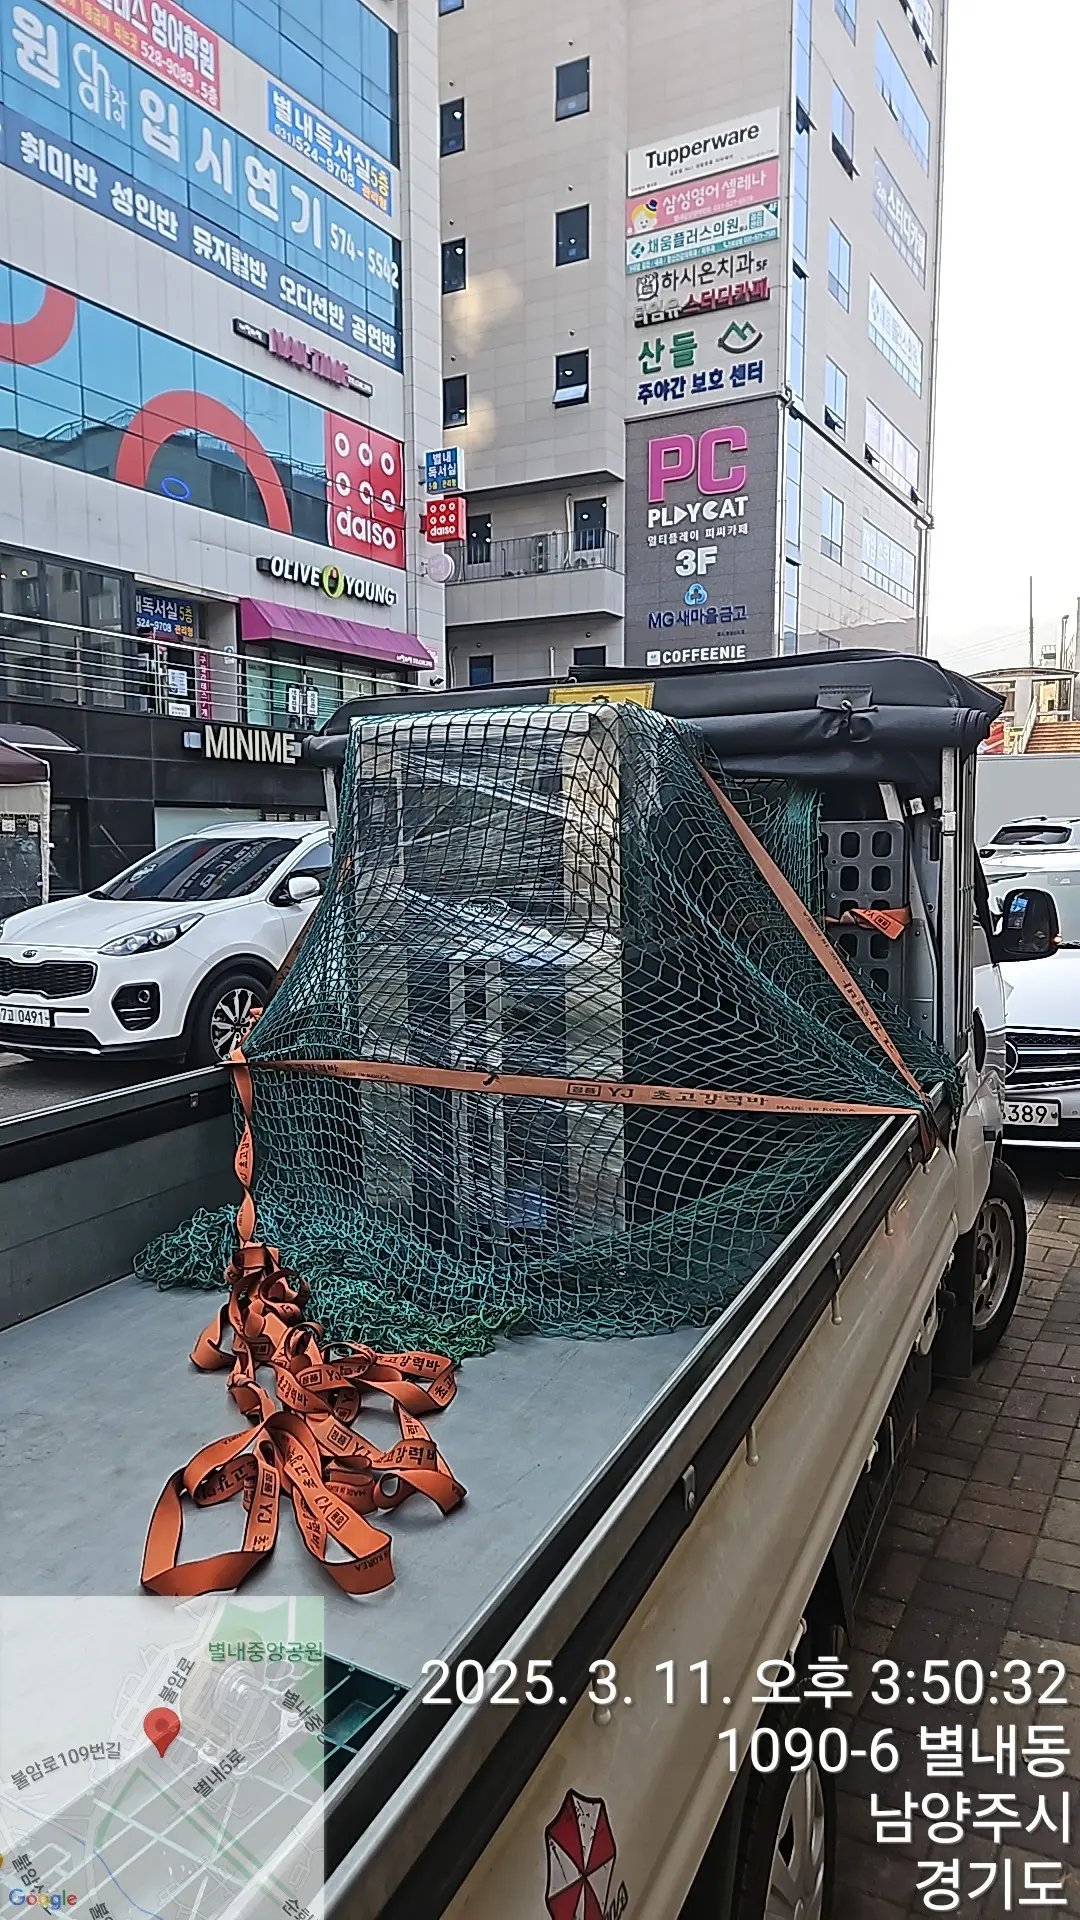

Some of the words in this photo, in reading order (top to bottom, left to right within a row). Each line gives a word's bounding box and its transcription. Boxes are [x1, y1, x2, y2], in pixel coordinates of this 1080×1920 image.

[151, 2, 215, 82] 영어학원
[140, 40, 194, 88] 528-9089
[645, 124, 760, 169] Tupperware
[662, 182, 720, 215] 삼성영어
[722, 171, 767, 198] 셀레나
[20, 131, 98, 199] 취미반
[110, 180, 179, 242] 성인반
[192, 226, 268, 291] 뮤지컬반
[279, 275, 345, 332] 오디션반
[351, 314, 396, 360] 공연반
[647, 217, 739, 254] 채움플러스의원
[662, 250, 754, 292] 하시온치과
[756, 259, 768, 271] 5F
[638, 376, 686, 405] 주야간
[691, 368, 724, 394] 보호
[730, 360, 763, 388] 센터
[428, 463, 456, 478] 독서실
[433, 452, 451, 465] 별내
[648, 425, 748, 503] PC
[337, 506, 396, 550] daiso
[430, 525, 456, 537] daiso
[704, 524, 749, 541] 피씨카페
[675, 546, 718, 577] 3F
[270, 556, 320, 586] OLIVE
[345, 577, 396, 606] YOUNG
[662, 645, 746, 663] COFFEENIE
[204, 724, 297, 765] MINIME
[18, 1009, 44, 1024] 0491
[608, 1087, 634, 1099] YJ
[651, 1089, 769, 1106] 초고강력바
[776, 1104, 804, 1112] MADE
[1001, 1103, 1047, 1123] 389
[326, 1368, 342, 1382] YJ
[257, 1503, 273, 1524] YJ
[314, 1496, 333, 1514] YJ
